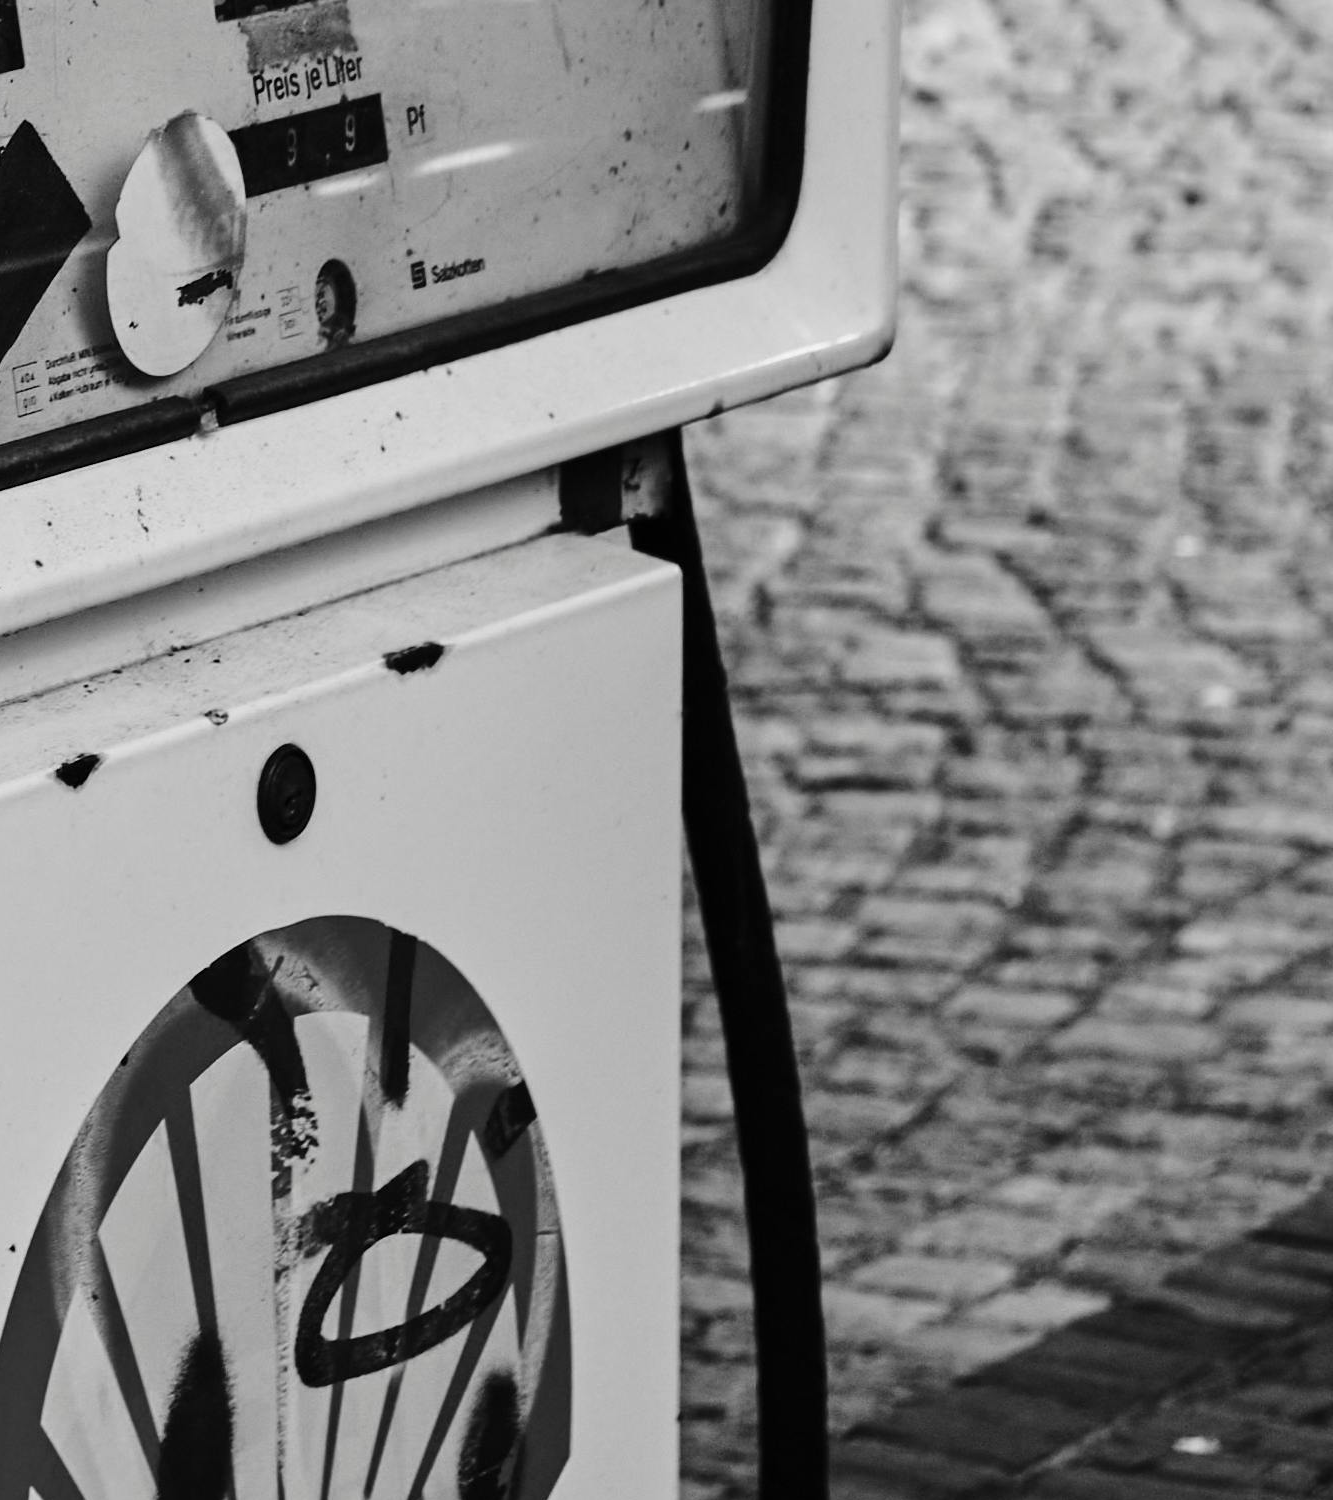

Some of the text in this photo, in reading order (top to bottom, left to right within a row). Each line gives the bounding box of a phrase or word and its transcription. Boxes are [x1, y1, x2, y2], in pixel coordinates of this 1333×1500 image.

[253, 55, 363, 105] Preis je Liter
[407, 104, 426, 136] Pf
